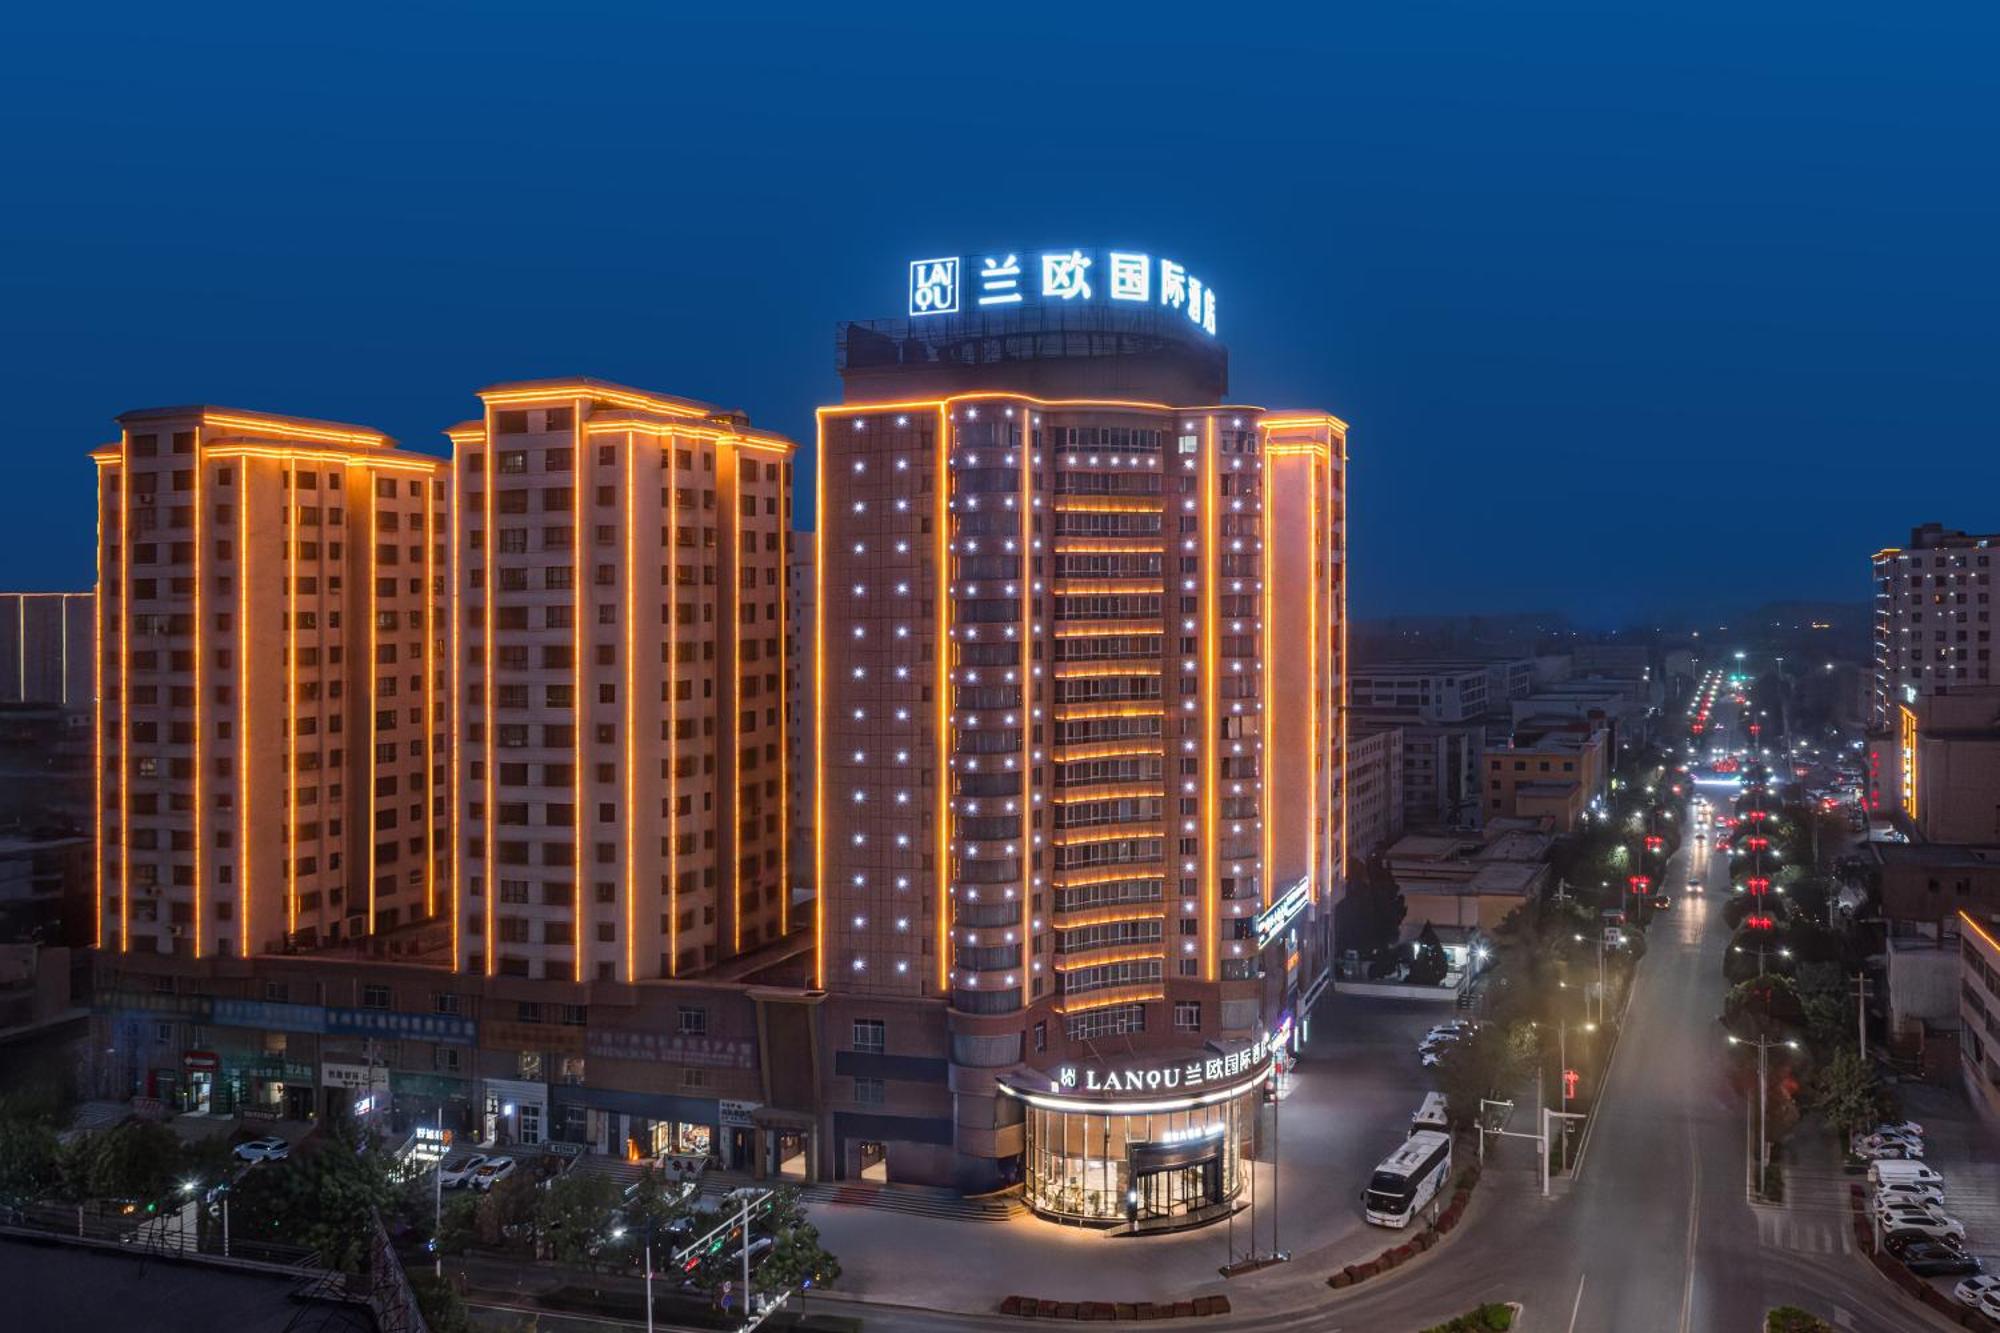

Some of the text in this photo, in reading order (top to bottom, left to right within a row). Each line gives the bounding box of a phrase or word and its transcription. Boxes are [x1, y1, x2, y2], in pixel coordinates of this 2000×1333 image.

[978, 250, 1217, 336] 兰欧国际酒店
